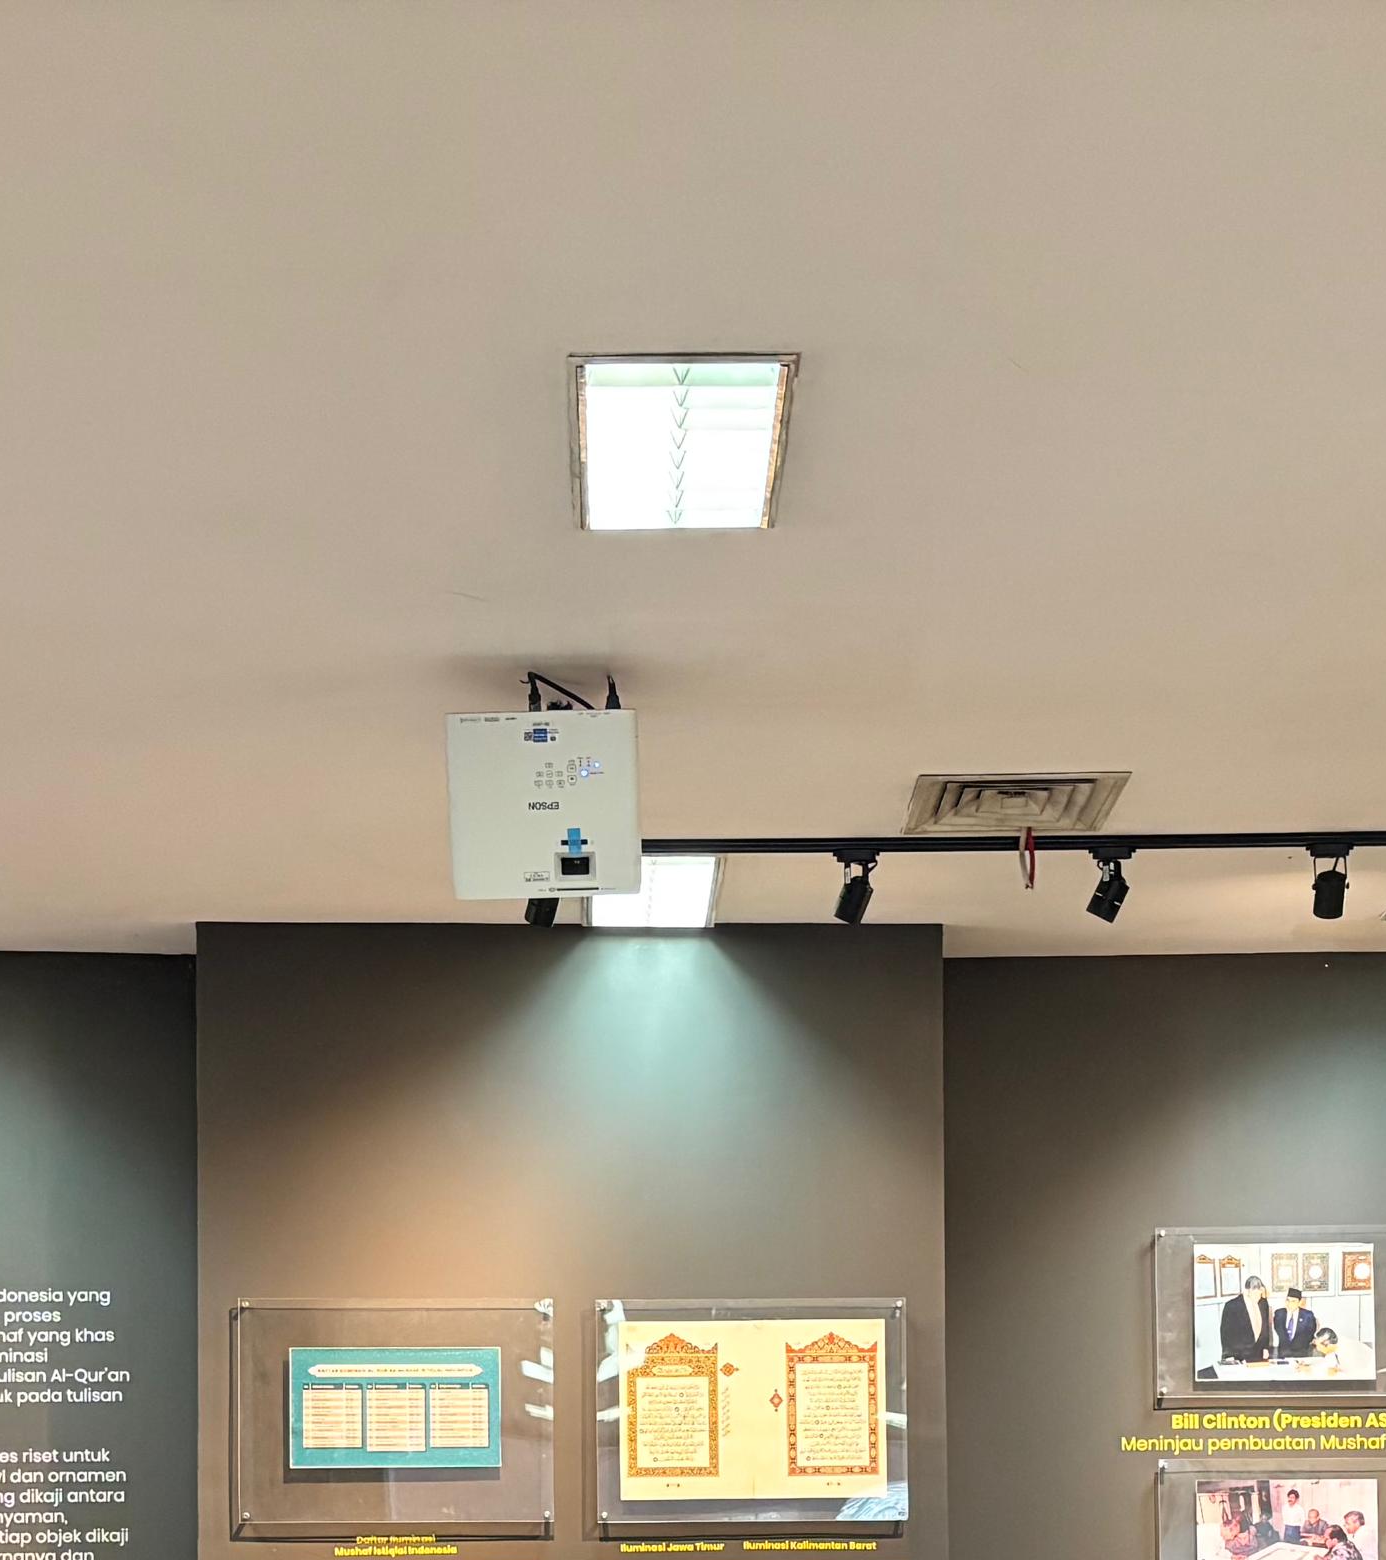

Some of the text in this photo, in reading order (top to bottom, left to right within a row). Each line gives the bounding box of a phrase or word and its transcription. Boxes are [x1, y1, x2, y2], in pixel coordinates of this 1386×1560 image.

[527, 801, 560, 811] EPSON
[67, 1292, 111, 1307] yang
[3, 1312, 62, 1327] proses
[26, 1332, 71, 1347] yang
[75, 1327, 115, 1343] khas
[50, 1367, 130, 1384] Al-Qur'an
[16, 1387, 63, 1407] pada
[66, 1387, 123, 1402] tulisan
[1171, 1412, 1201, 1430] Bill
[1202, 1412, 1271, 1430] Clinton
[1273, 1409, 1363, 1432] (Presiden
[1121, 1435, 1204, 1455] Meninjau
[1207, 1434, 1317, 1455] pembuatan
[1319, 1433, 1386, 1451] Mushaf
[334, 1545, 372, 1557] Mushaf
[408, 1543, 459, 1556] Indonesia
[667, 1542, 694, 1553] Jawa
[695, 1541, 725, 1552] Timur
[790, 1540, 848, 1551] Kalimantan
[849, 1541, 877, 1551] Barat
